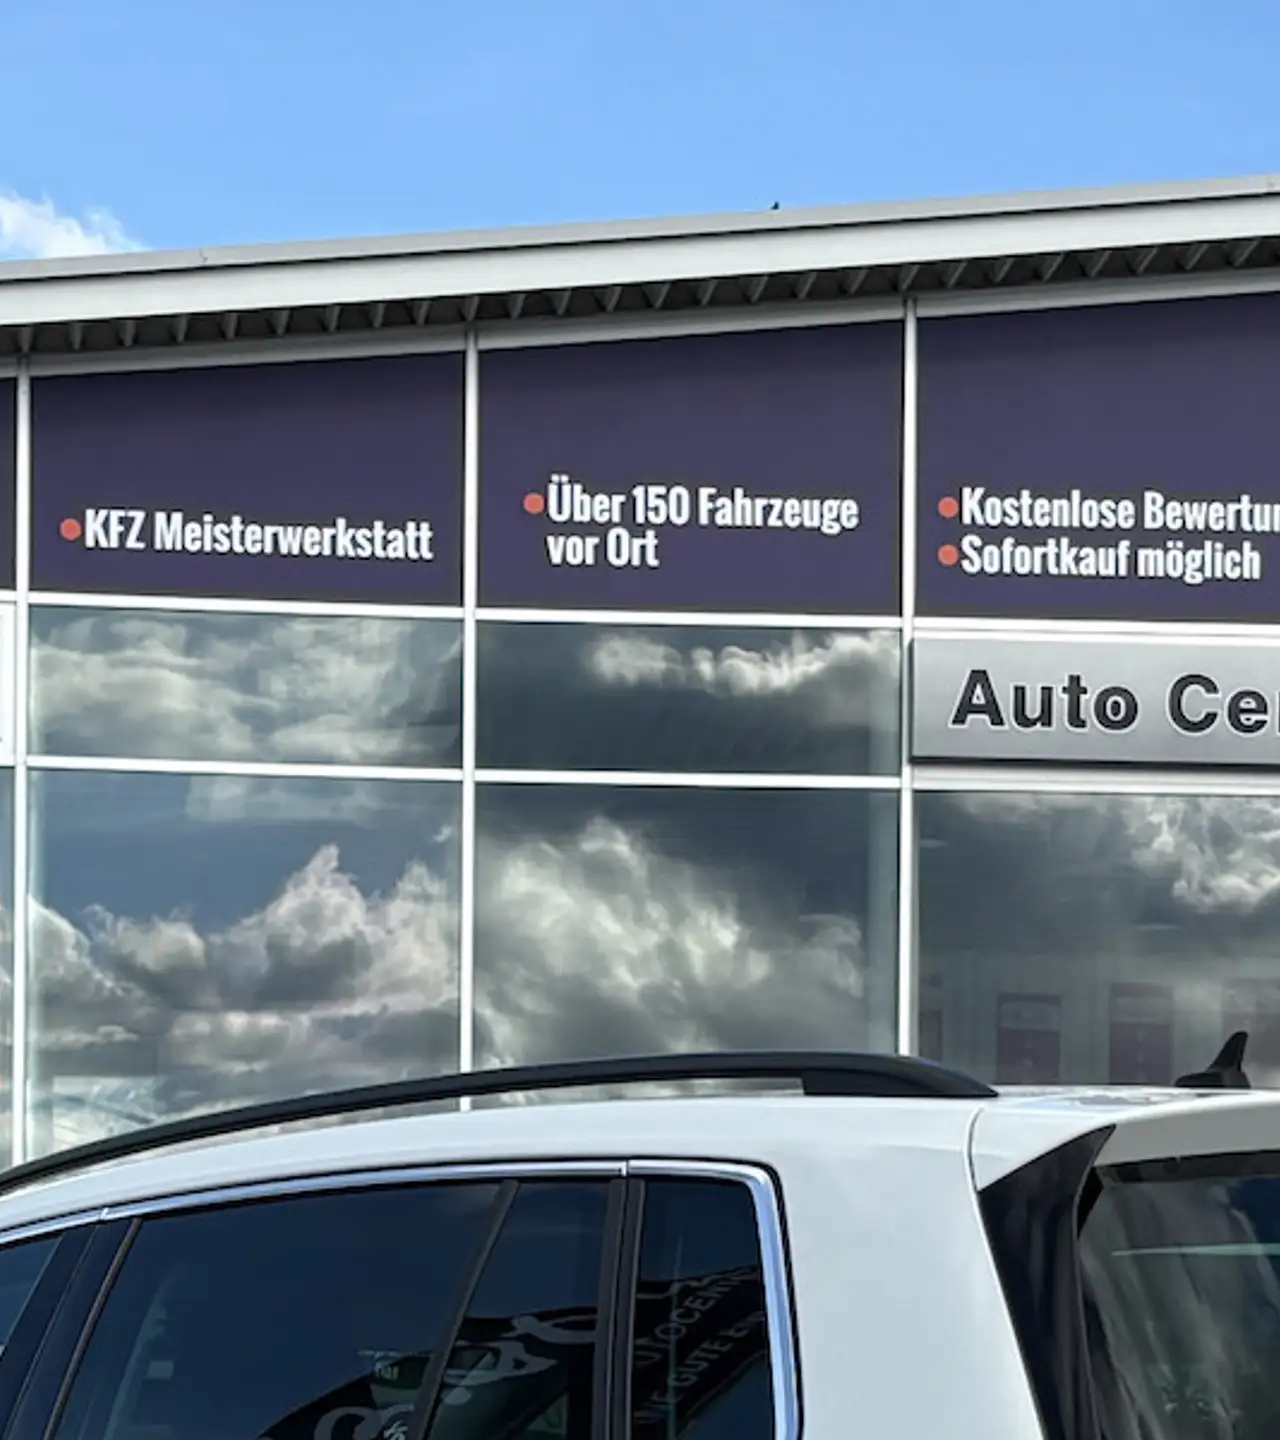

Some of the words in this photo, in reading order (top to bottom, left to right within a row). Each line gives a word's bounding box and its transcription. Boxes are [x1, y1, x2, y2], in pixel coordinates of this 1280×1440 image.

[547, 473, 627, 524] Über
[631, 485, 690, 526] 150
[698, 486, 859, 535] Fahrzeuge
[962, 486, 1136, 529] Kostenlose
[85, 508, 146, 550] KFZ
[154, 511, 434, 560] Meisterwerkstatt
[546, 535, 601, 565] vor
[606, 526, 660, 567] Ort
[961, 533, 1131, 577] Sofortkauf
[1137, 539, 1261, 585] möglich
[951, 668, 1139, 731] Auto
